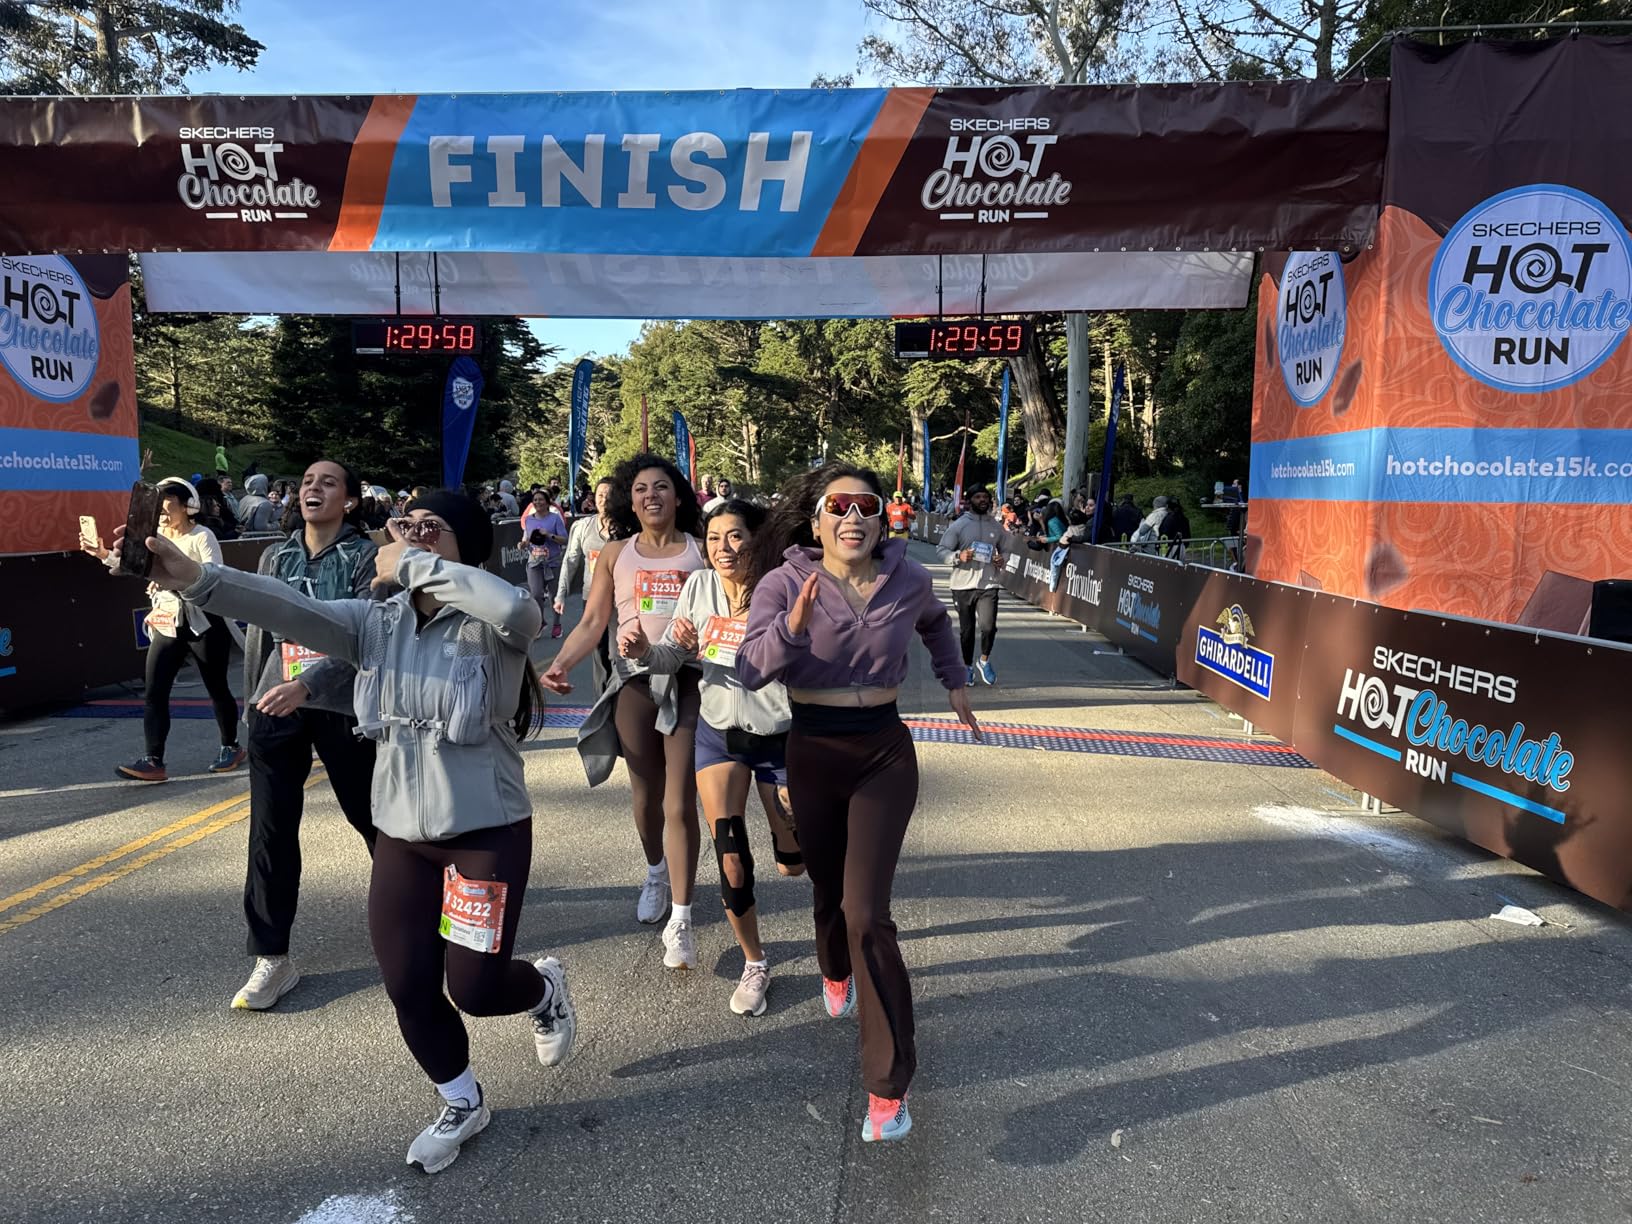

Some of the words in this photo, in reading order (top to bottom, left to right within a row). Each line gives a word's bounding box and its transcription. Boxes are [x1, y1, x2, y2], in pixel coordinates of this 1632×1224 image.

[179, 127, 275, 139] SKECHERS
[950, 118, 1050, 131] SKECHERS
[180, 141, 284, 182] HOT
[429, 130, 813, 212] FINISH
[942, 134, 1059, 179] HOT
[177, 173, 321, 209] Chocolate
[921, 167, 1072, 210] Chocolate
[241, 210, 272, 222] RUN
[977, 210, 1010, 223] RUN
[1472, 221, 1601, 237] SKECHERS
[2, 258, 74, 286] SKECHERS
[1287, 253, 1330, 283] SKECHERS
[1462, 242, 1610, 294] HOT
[4, 276, 81, 329] HOT
[1285, 271, 1334, 328] HOT
[1435, 285, 1632, 335] Chocolate
[1280, 312, 1344, 365] Chocolate
[1492, 337, 1570, 365] RUN
[31, 355, 74, 384] RUN
[1296, 357, 1322, 386] RUN
[643, 600, 650, 609] N
[1199, 636, 1269, 688] GHIRARDELLI
[1373, 646, 1517, 703] SKECHERS
[1337, 668, 1420, 738] HOT
[1405, 688, 1574, 792] Chocolate
[1405, 748, 1447, 784] RUN
[450, 895, 492, 917] 32422
